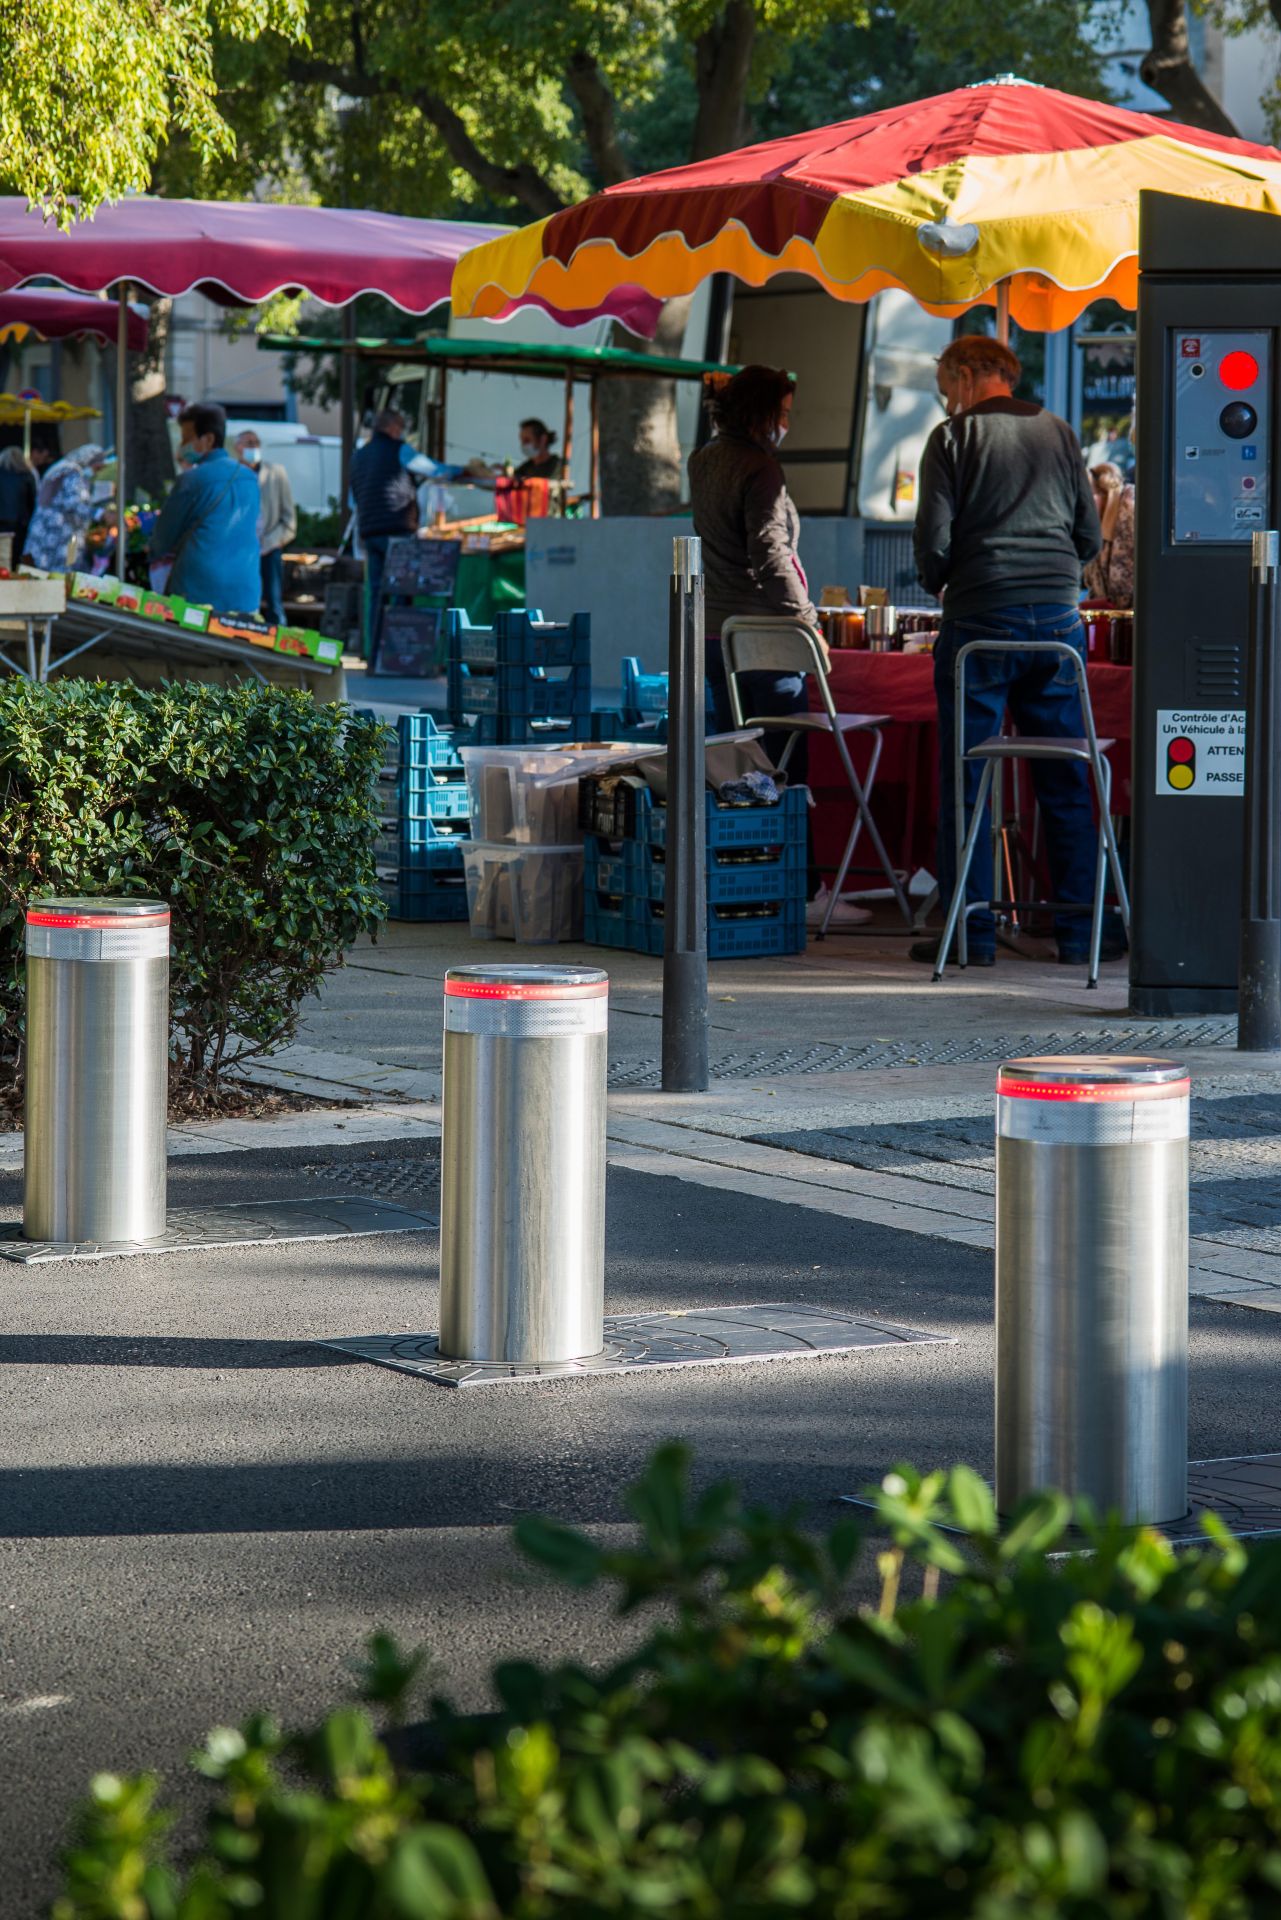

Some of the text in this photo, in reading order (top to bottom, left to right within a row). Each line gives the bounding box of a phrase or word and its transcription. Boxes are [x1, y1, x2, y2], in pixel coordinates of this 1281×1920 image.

[1172, 713, 1245, 722] Contrôle d'Ac
[1162, 724, 1178, 734] Un
[1180, 724, 1226, 734] Véhicule
[1228, 725, 1235, 734] à
[1207, 746, 1245, 756] ATTEN
[1206, 772, 1244, 782] PASSE
